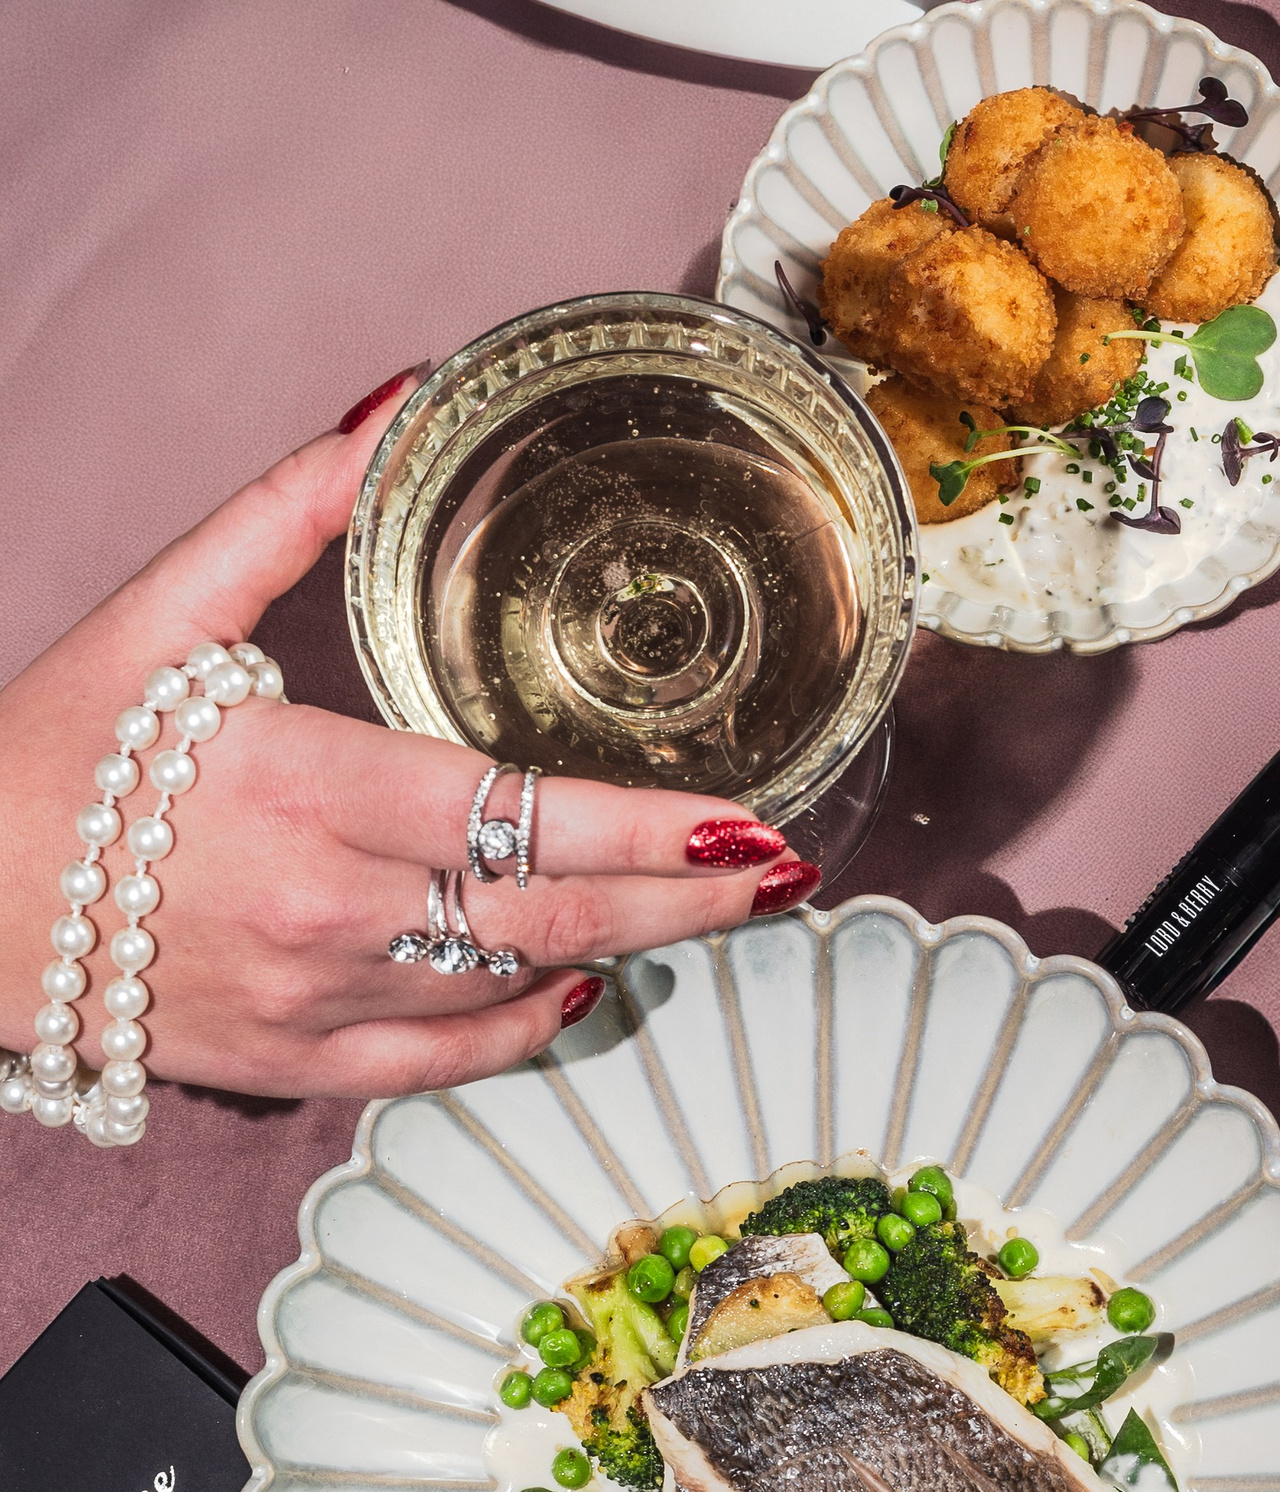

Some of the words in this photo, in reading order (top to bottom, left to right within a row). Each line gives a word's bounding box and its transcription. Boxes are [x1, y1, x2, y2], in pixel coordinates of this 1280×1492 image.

[1178, 875, 1220, 919] BERRY
[1171, 911, 1191, 928] &
[1144, 920, 1181, 958] LORD
